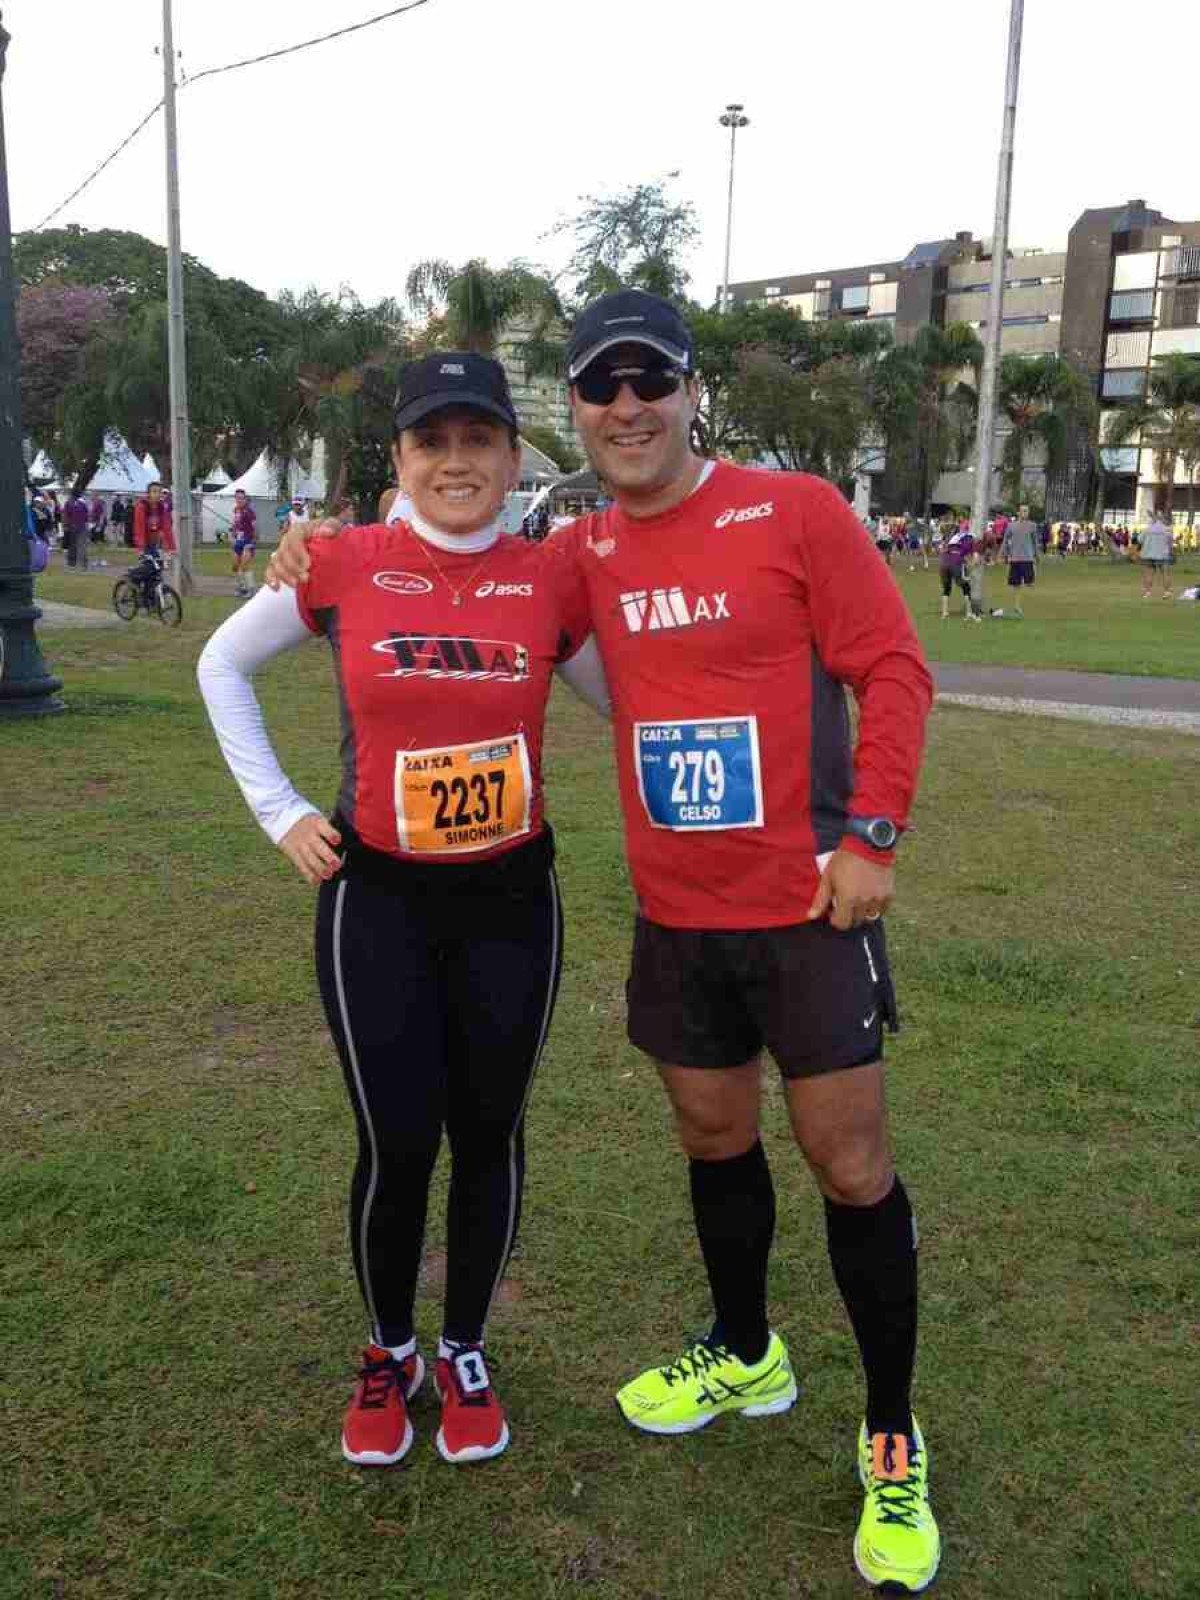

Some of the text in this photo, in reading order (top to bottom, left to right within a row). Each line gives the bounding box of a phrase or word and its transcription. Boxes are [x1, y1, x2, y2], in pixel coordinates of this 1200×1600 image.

[735, 502, 773, 522] asics
[494, 581, 533, 596] asics
[669, 748, 725, 803] 279
[431, 769, 505, 829] 2237
[679, 804, 721, 821] CELSO
[445, 822, 504, 845] SIMONNE
